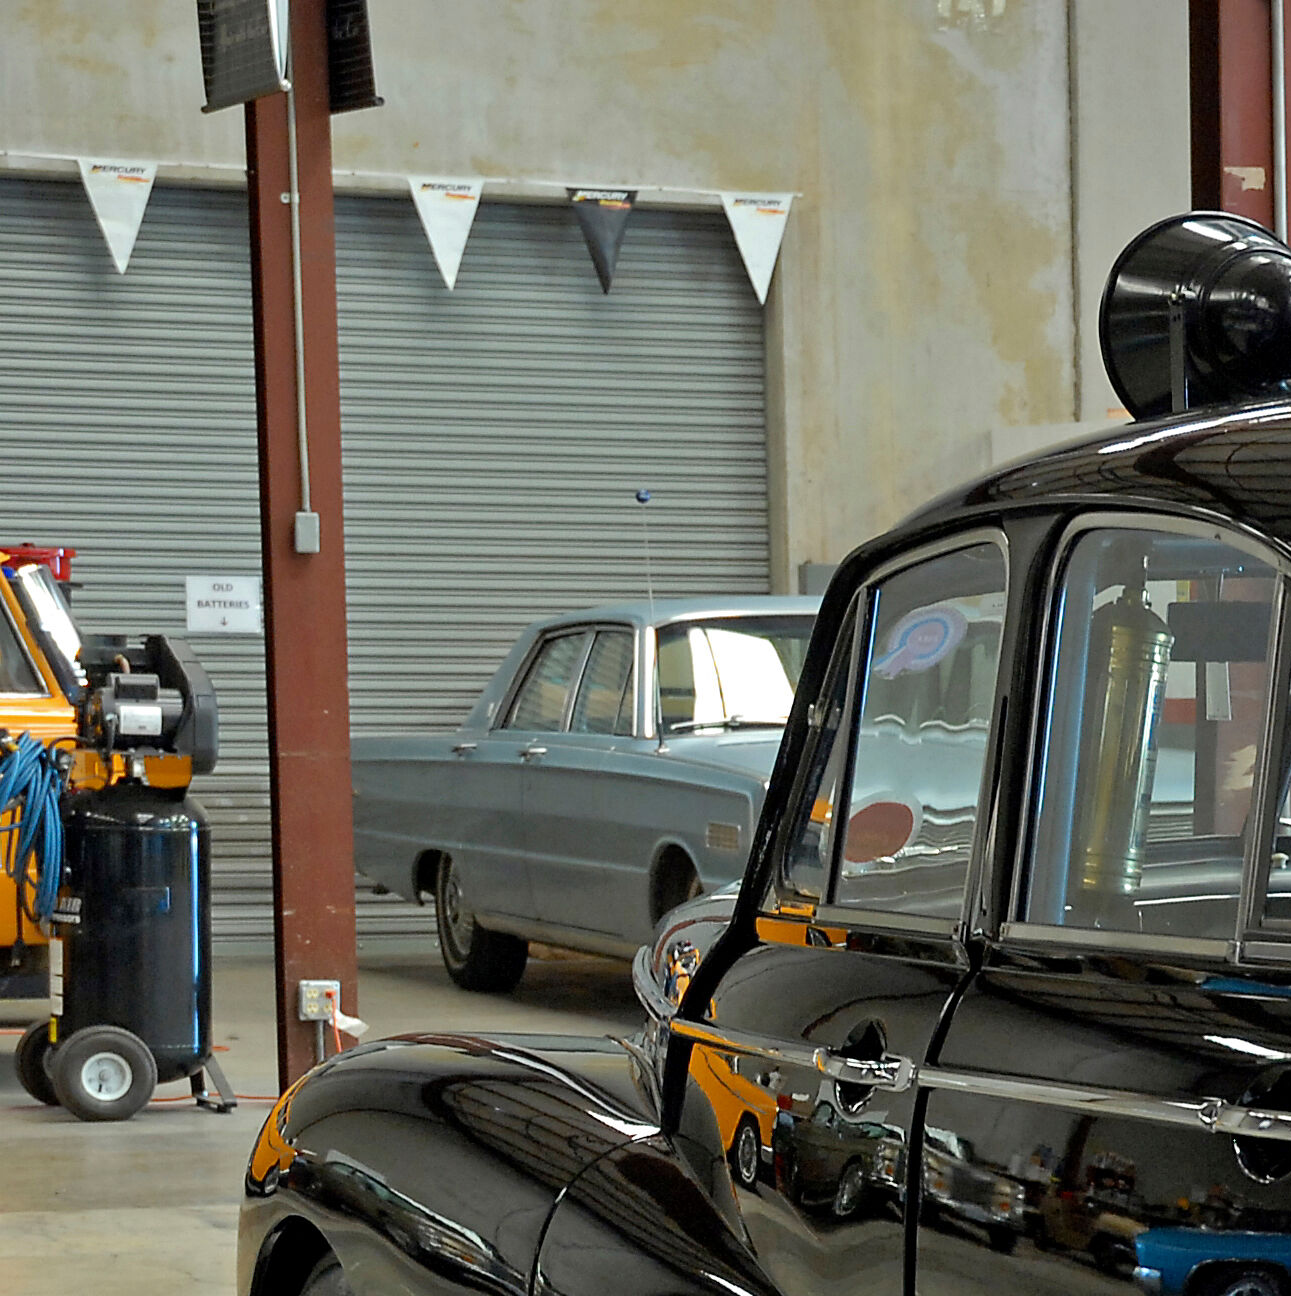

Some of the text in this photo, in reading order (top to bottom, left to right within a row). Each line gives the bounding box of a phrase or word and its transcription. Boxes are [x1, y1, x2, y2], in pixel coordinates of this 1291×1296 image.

[90, 164, 147, 175] MERCURY
[212, 583, 233, 592] OLD
[197, 600, 250, 609] BATTERIES
